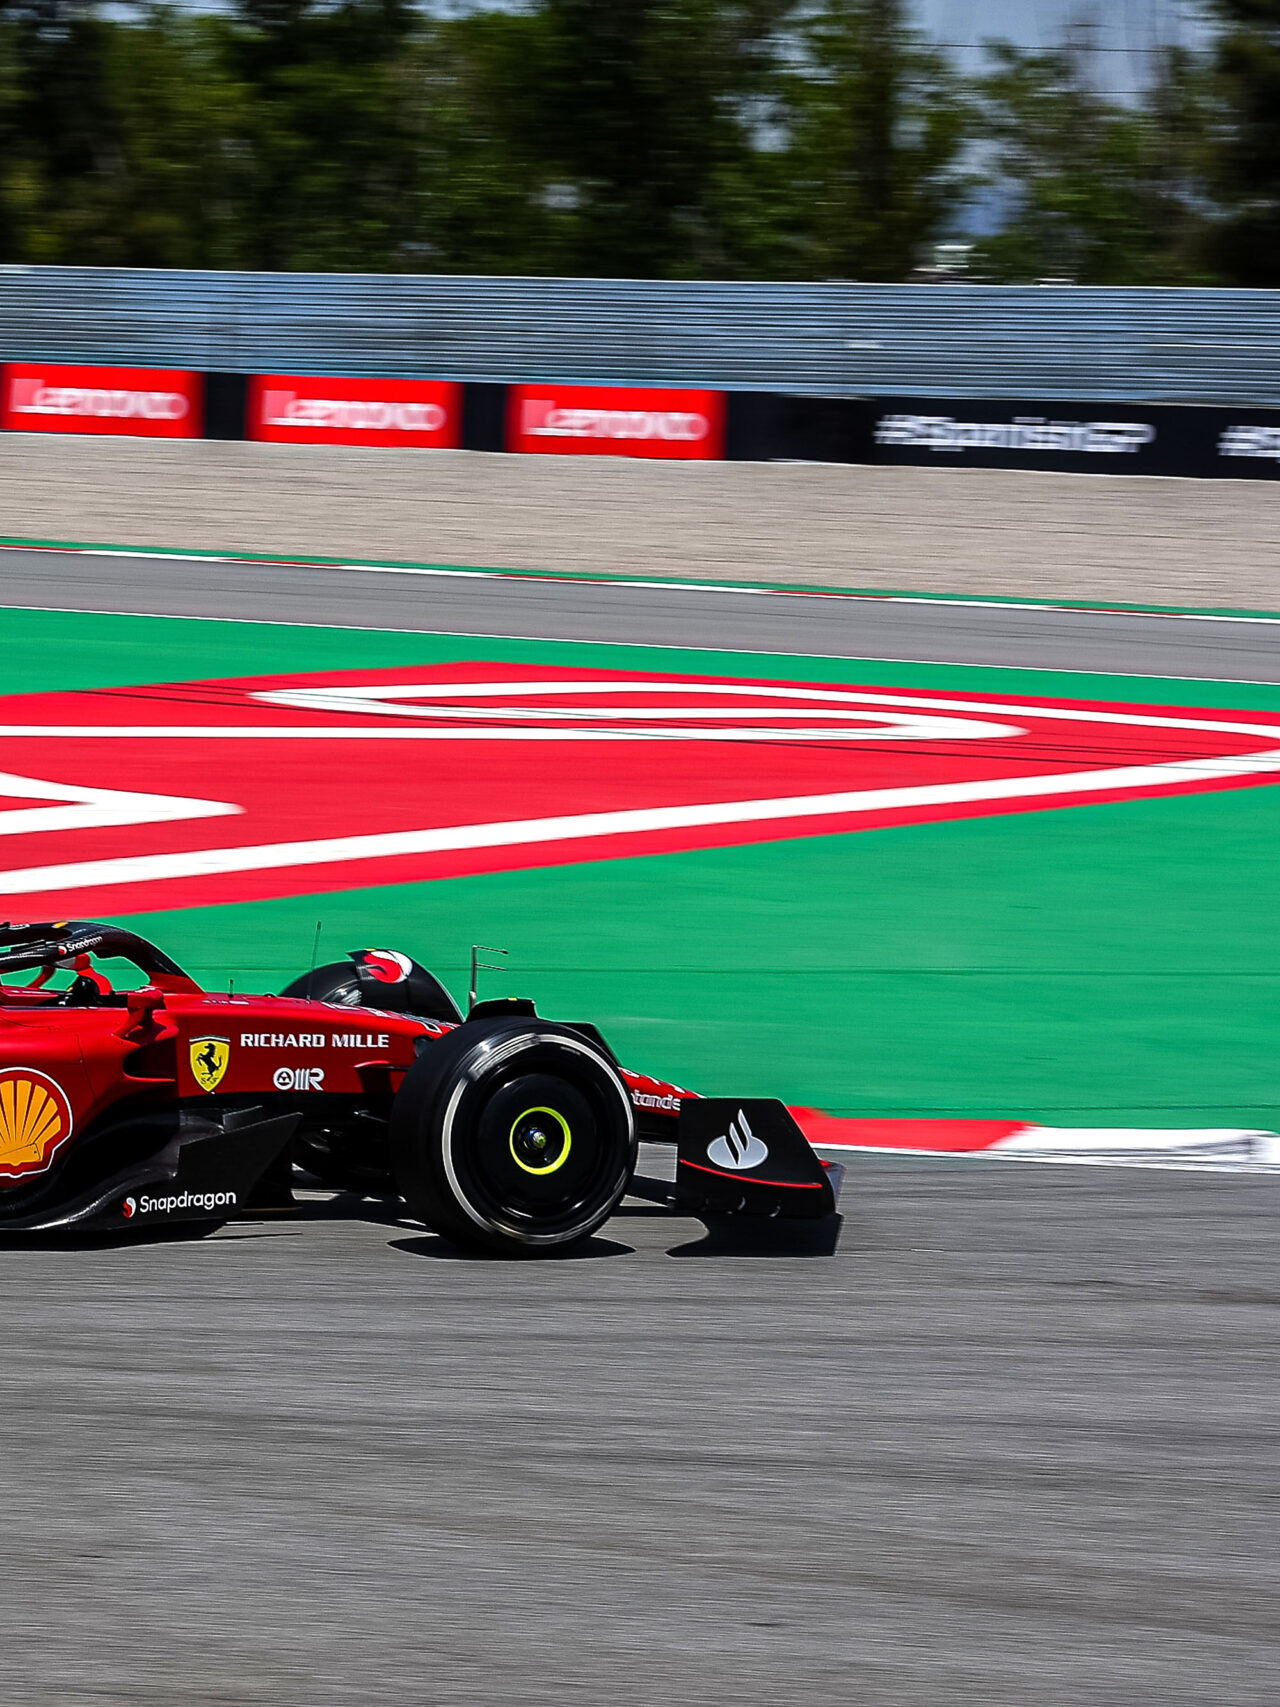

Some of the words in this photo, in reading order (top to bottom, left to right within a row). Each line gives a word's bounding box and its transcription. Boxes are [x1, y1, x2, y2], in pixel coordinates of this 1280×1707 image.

[10, 378, 189, 420] Lenovo
[262, 390, 446, 431] Lenovo
[522, 399, 709, 441] Lenovo
[240, 1033, 325, 1048] RICHARD
[332, 1034, 389, 1048] MILLE
[140, 1190, 237, 1213] Snapdragon
